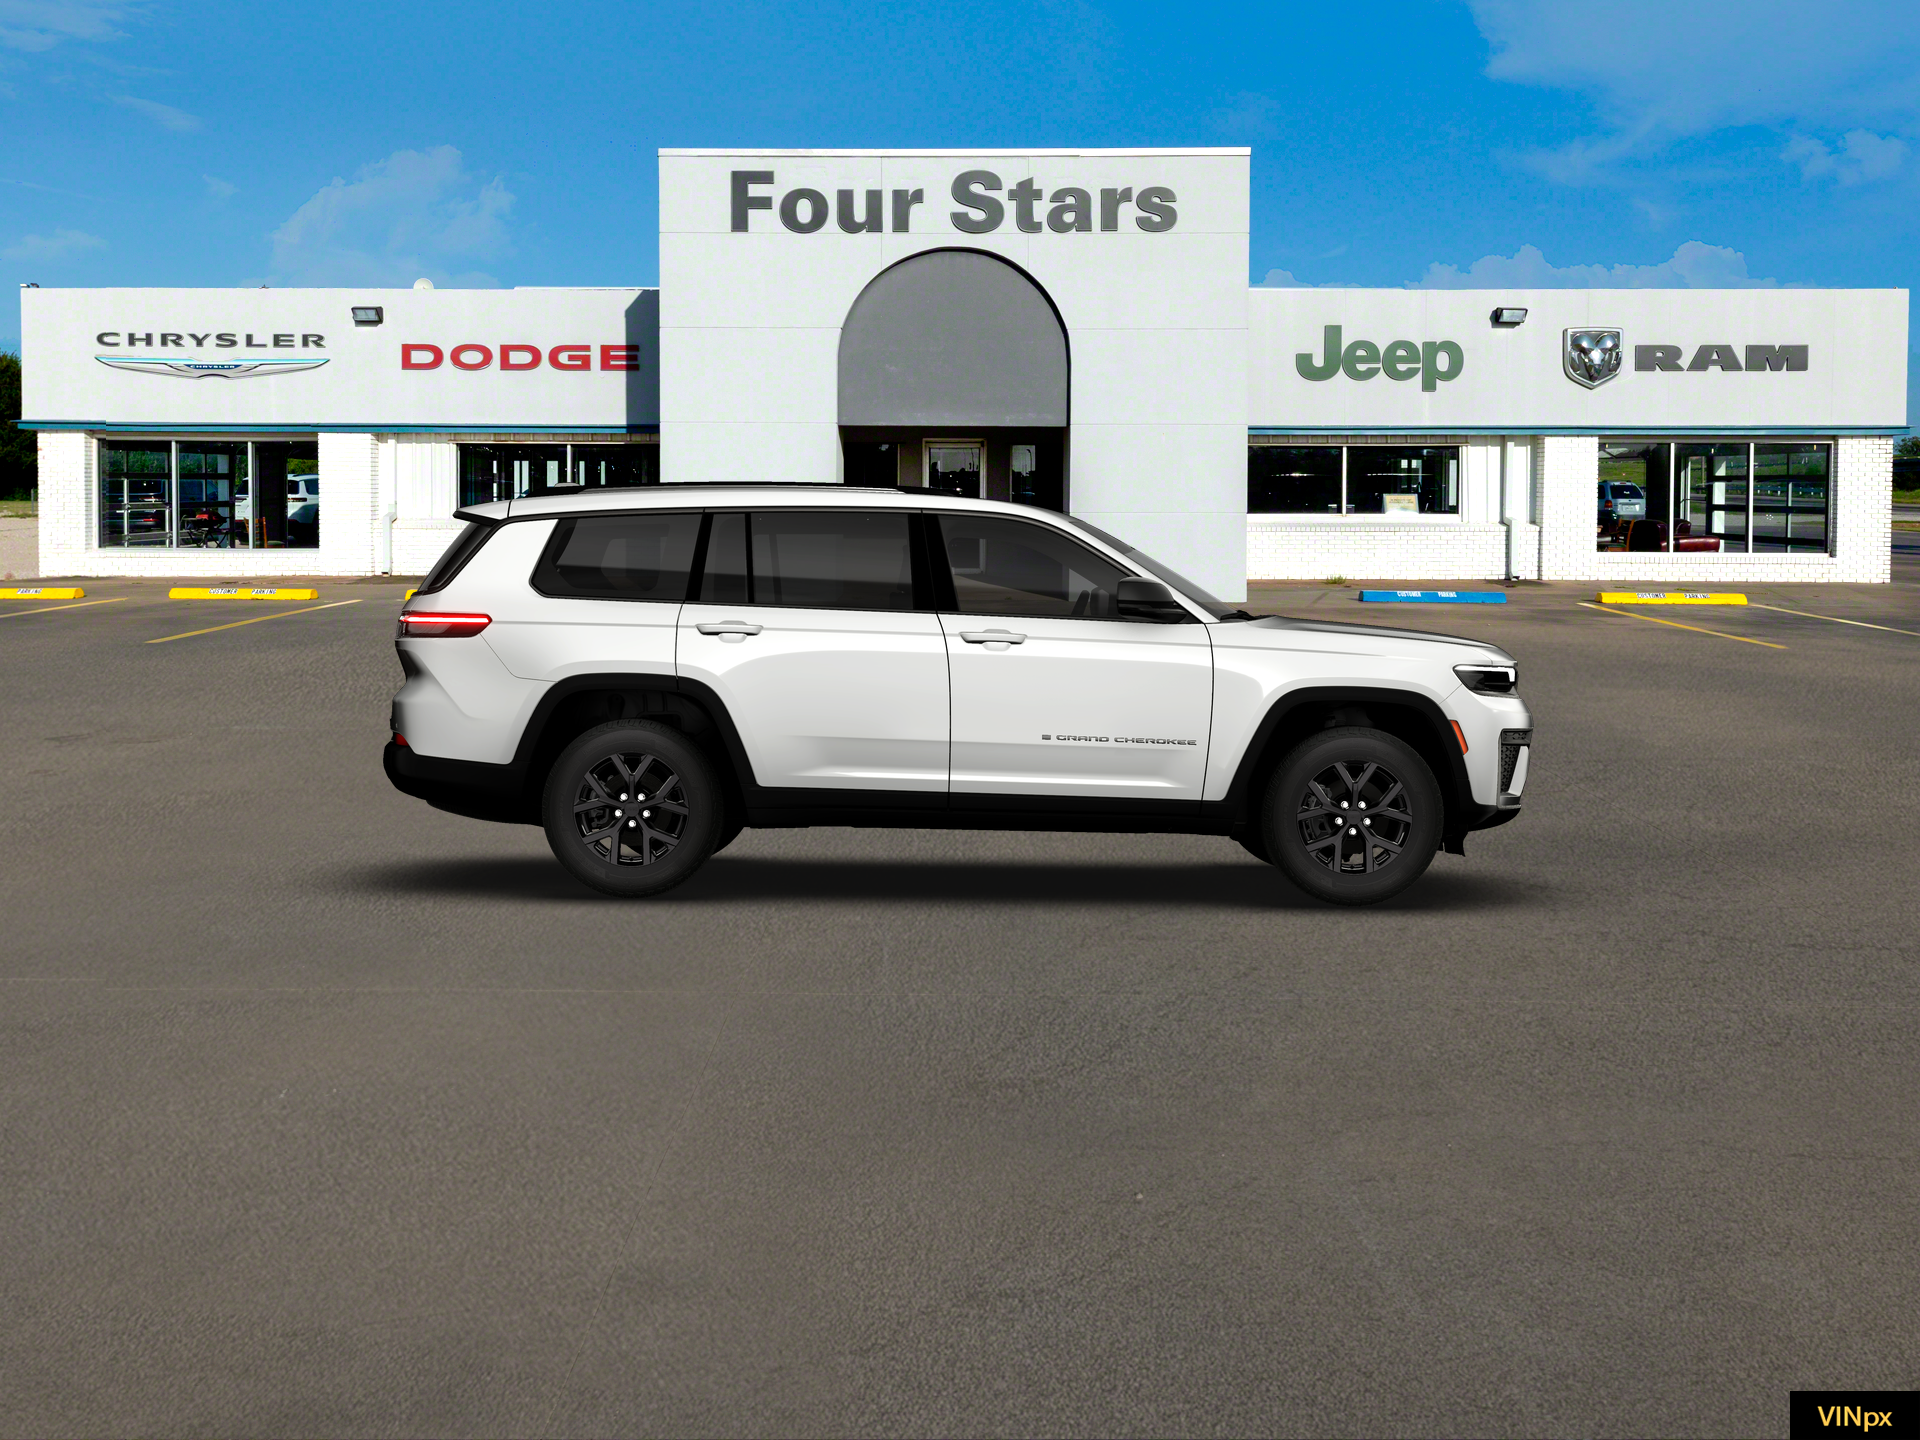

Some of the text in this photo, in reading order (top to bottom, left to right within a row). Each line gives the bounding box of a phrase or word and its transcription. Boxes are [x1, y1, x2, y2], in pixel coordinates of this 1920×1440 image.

[730, 169, 1179, 234] Four Stars
[96, 331, 327, 349] CHRYSLER
[401, 343, 640, 371] DODGE
[1295, 324, 1465, 393] Jeep
[1634, 344, 1809, 372] RAM
[1056, 734, 1198, 746] GRAND CHEROKEE
